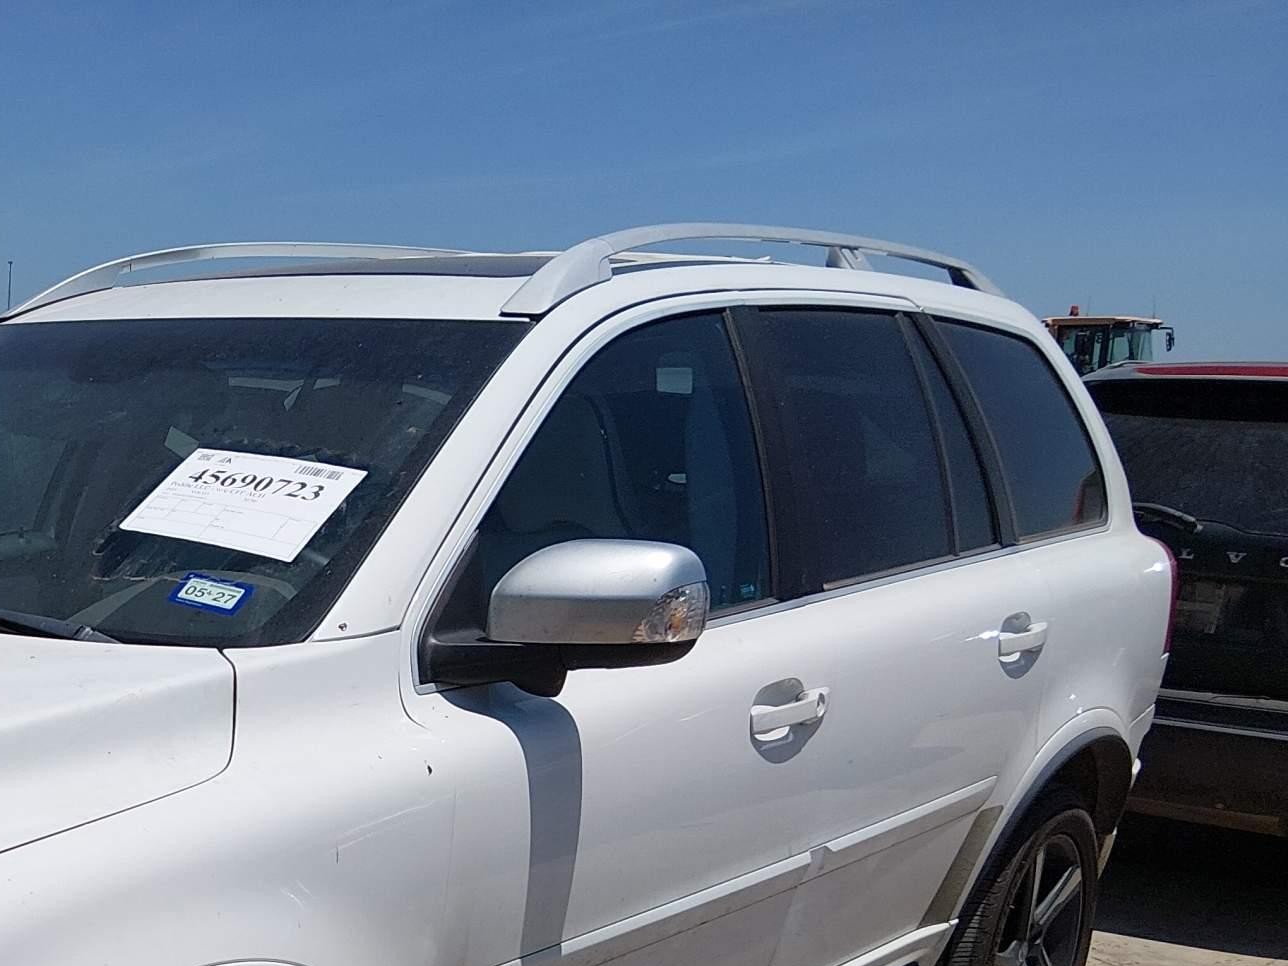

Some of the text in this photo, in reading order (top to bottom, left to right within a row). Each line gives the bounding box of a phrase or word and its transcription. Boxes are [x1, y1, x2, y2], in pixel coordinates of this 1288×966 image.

[188, 468, 326, 502] 45690723
[184, 585, 208, 598] 05
[211, 591, 238, 604] 27
